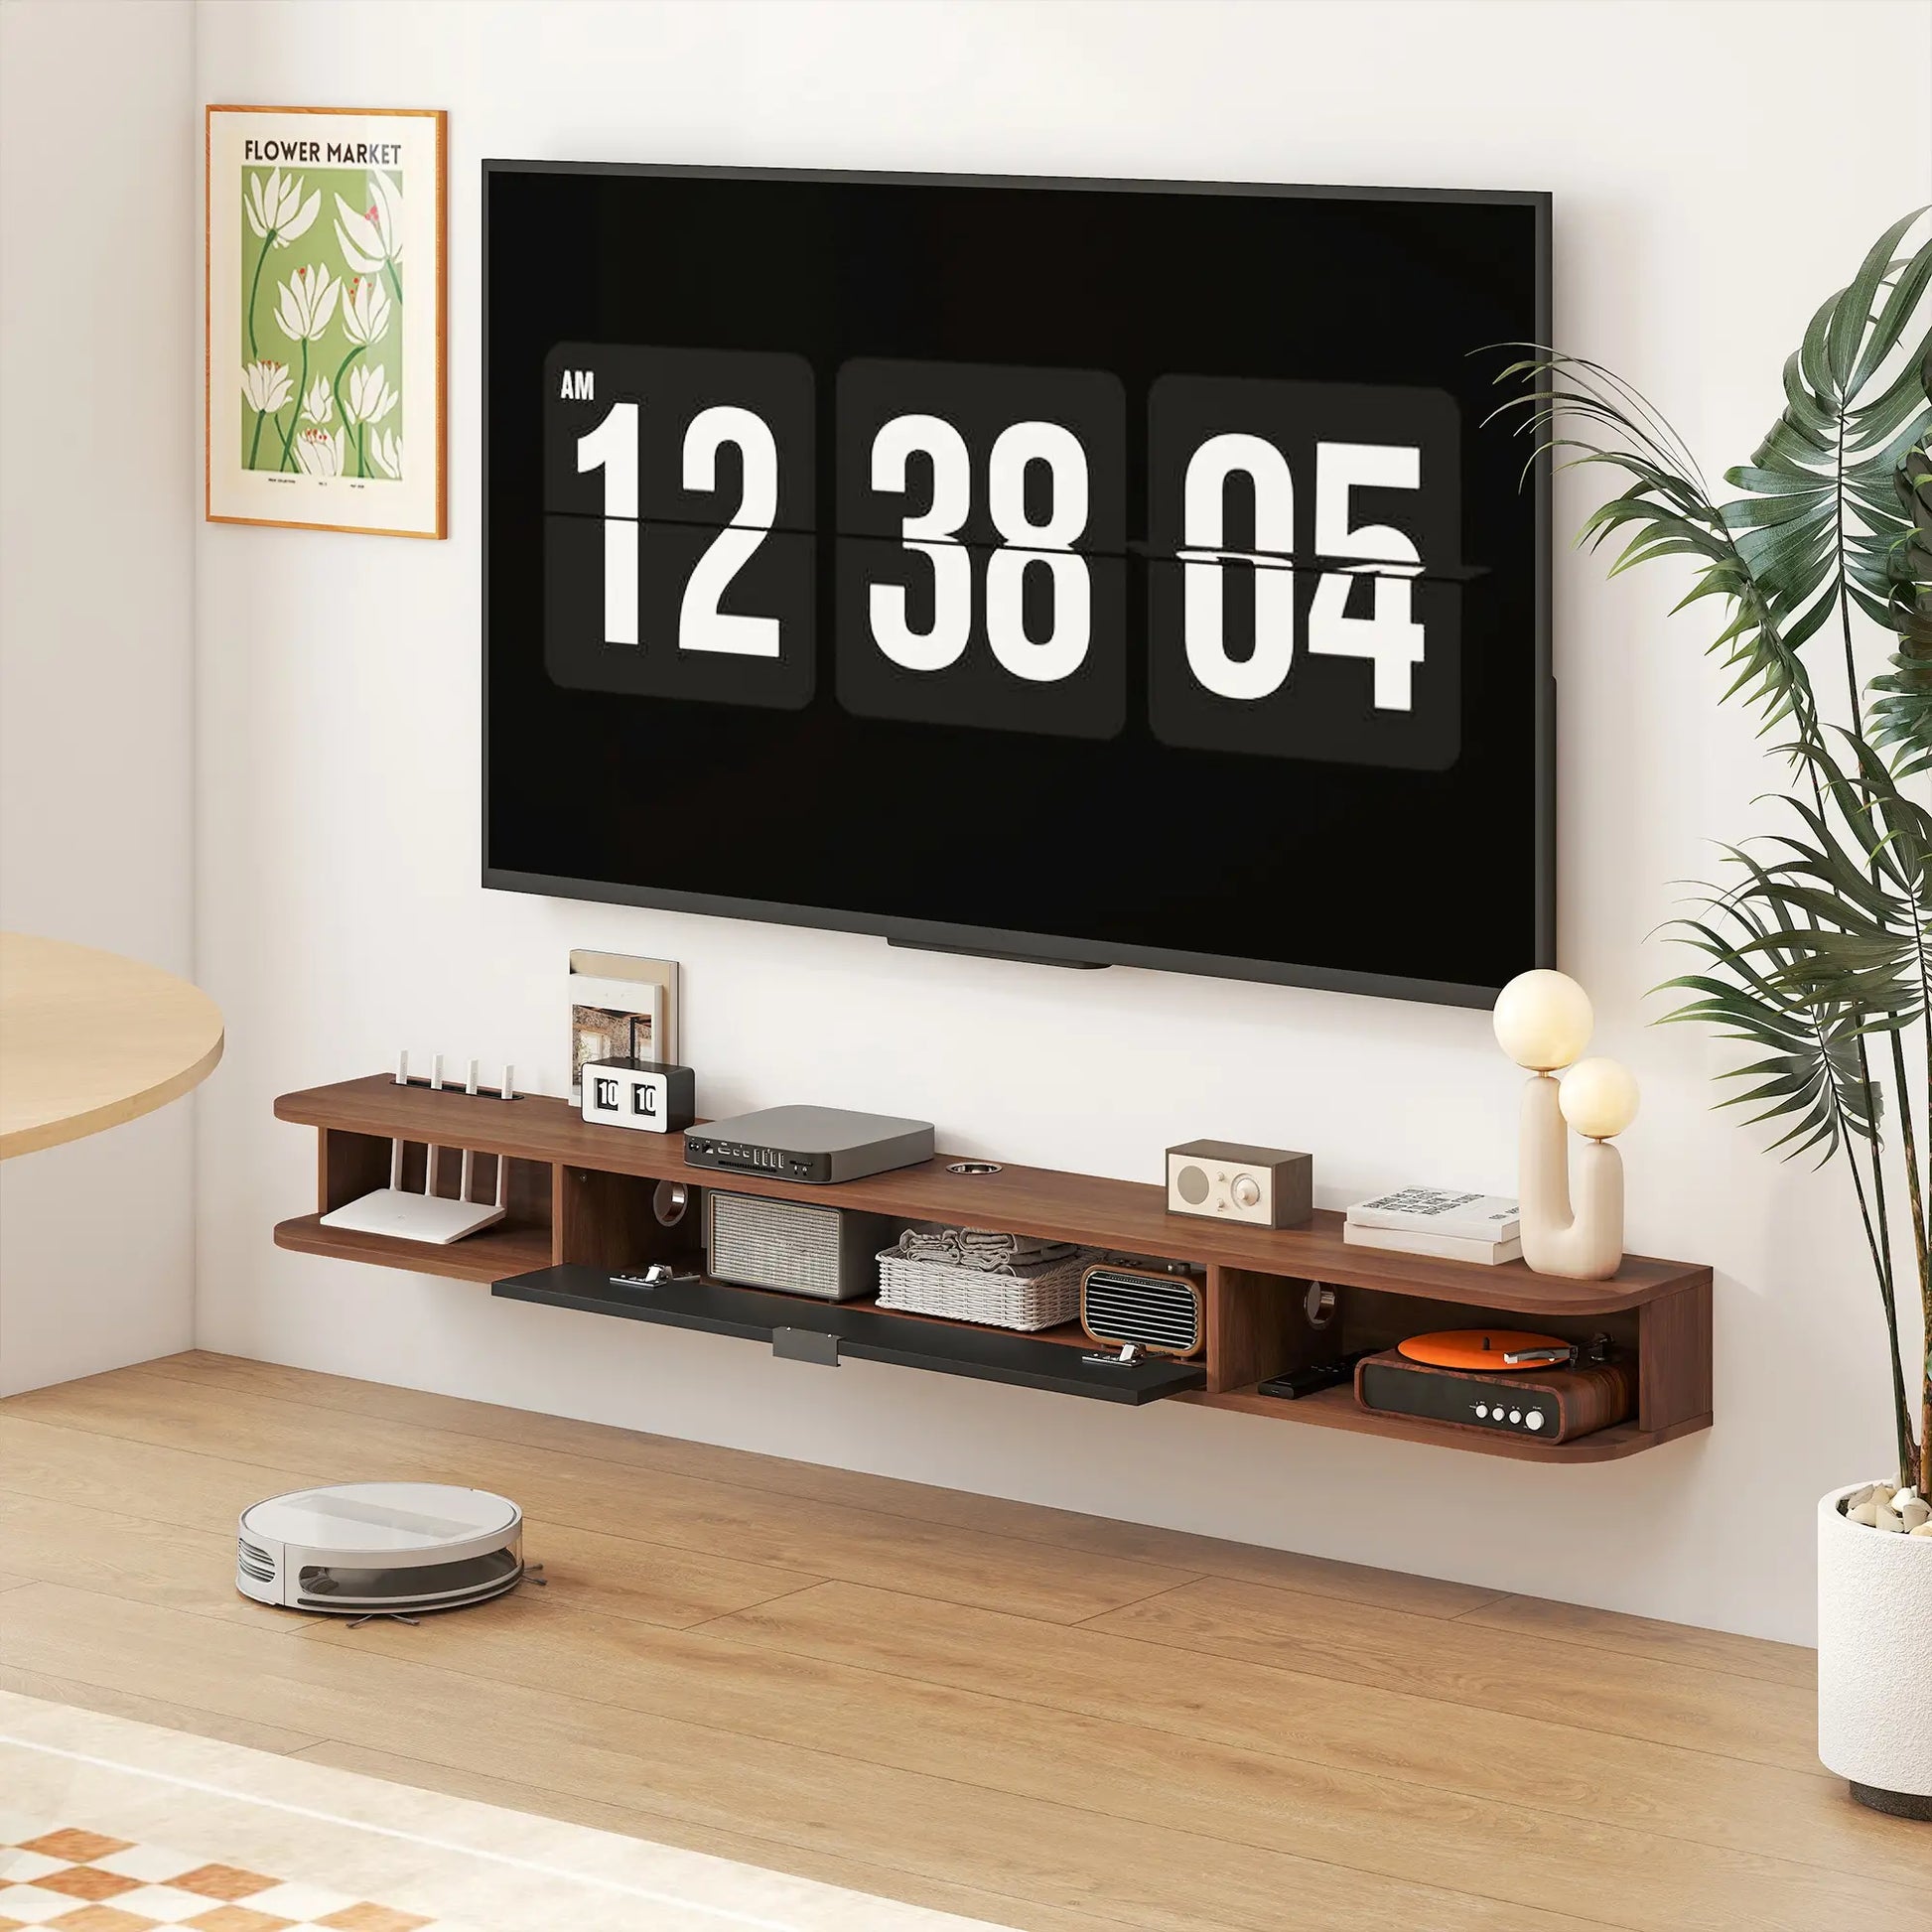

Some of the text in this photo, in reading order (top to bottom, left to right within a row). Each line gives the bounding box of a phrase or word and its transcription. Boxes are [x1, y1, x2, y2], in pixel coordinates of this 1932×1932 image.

[245, 140, 401, 164] FLOWER MARKET
[561, 370, 594, 400] AM
[578, 403, 779, 657] 12
[870, 415, 1090, 681] 38
[598, 1081, 656, 1112] 10 10
